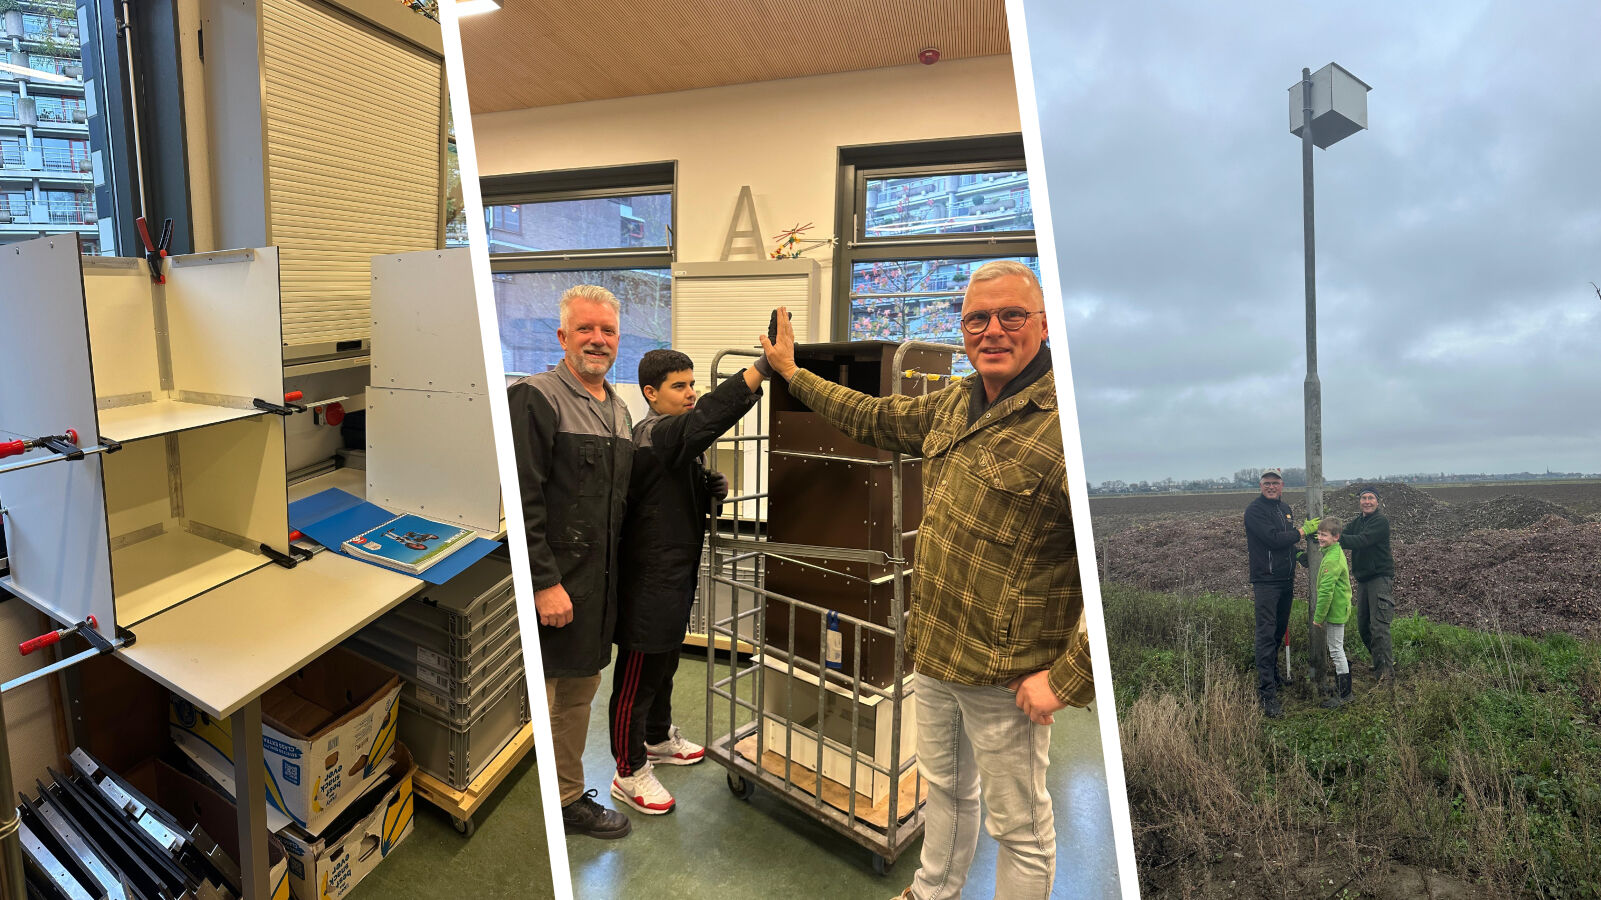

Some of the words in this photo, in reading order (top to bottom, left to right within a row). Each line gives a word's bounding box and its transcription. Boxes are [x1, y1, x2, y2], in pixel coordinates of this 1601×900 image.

[324, 765, 343, 782] ever
[320, 774, 341, 793] snack
[325, 780, 341, 797] best
[331, 853, 350, 875] ever
